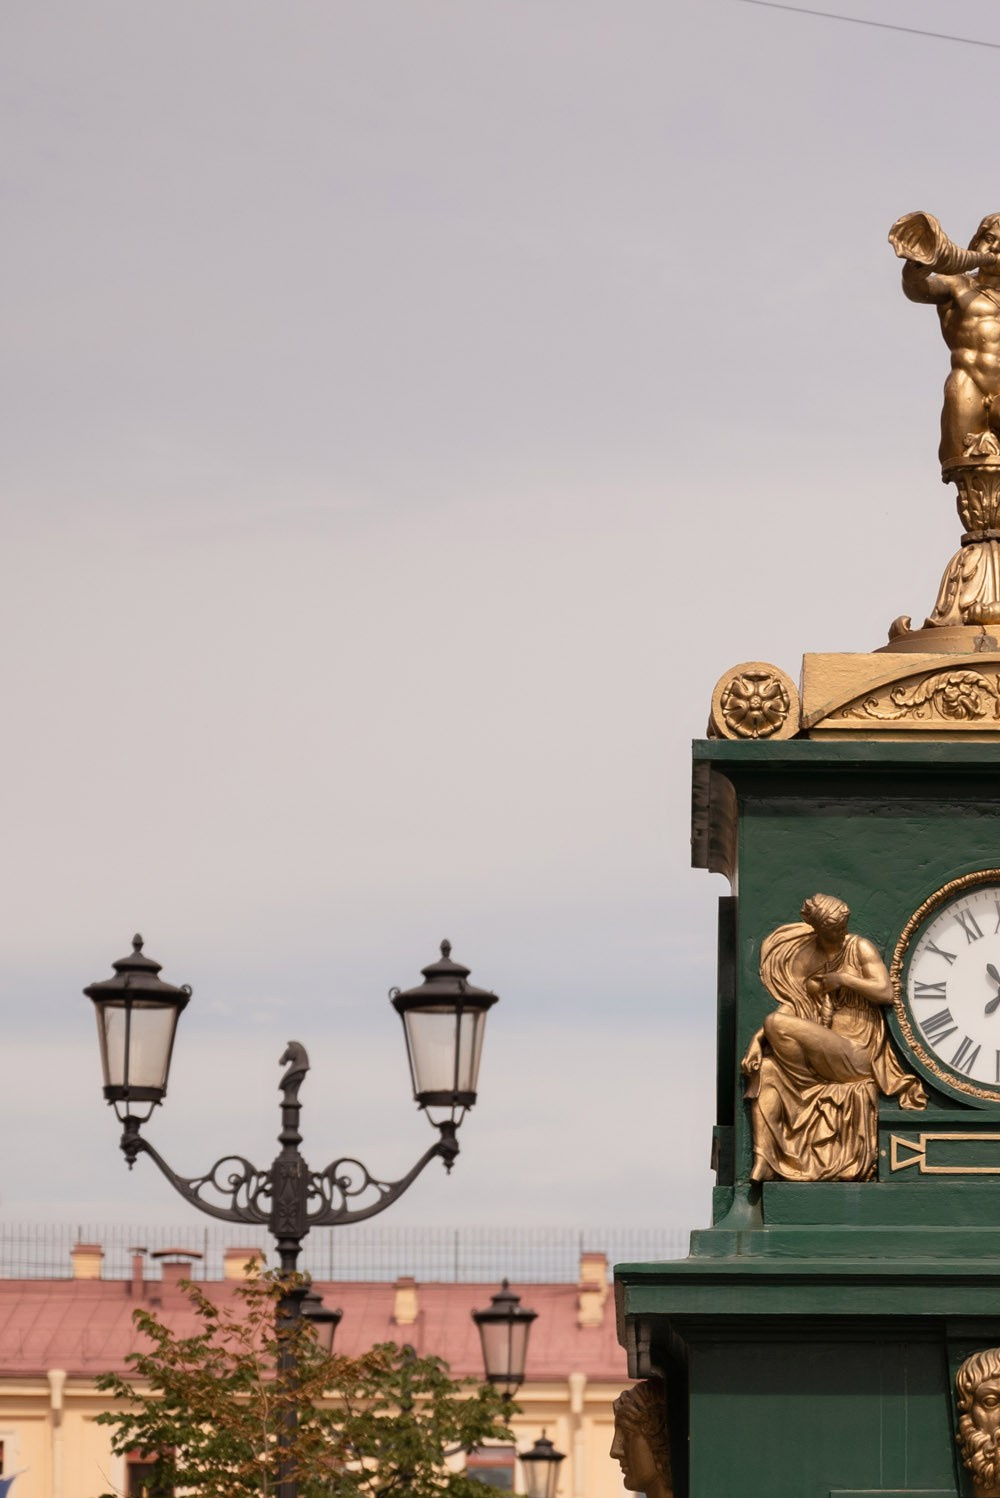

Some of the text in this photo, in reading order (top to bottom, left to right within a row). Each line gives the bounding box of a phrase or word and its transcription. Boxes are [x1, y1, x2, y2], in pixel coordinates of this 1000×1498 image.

[953, 908, 984, 944] XI
[924, 940, 958, 964] X
[914, 981, 947, 999] IX
[919, 1008, 958, 1046] VIII
[950, 1036, 982, 1074] VII
